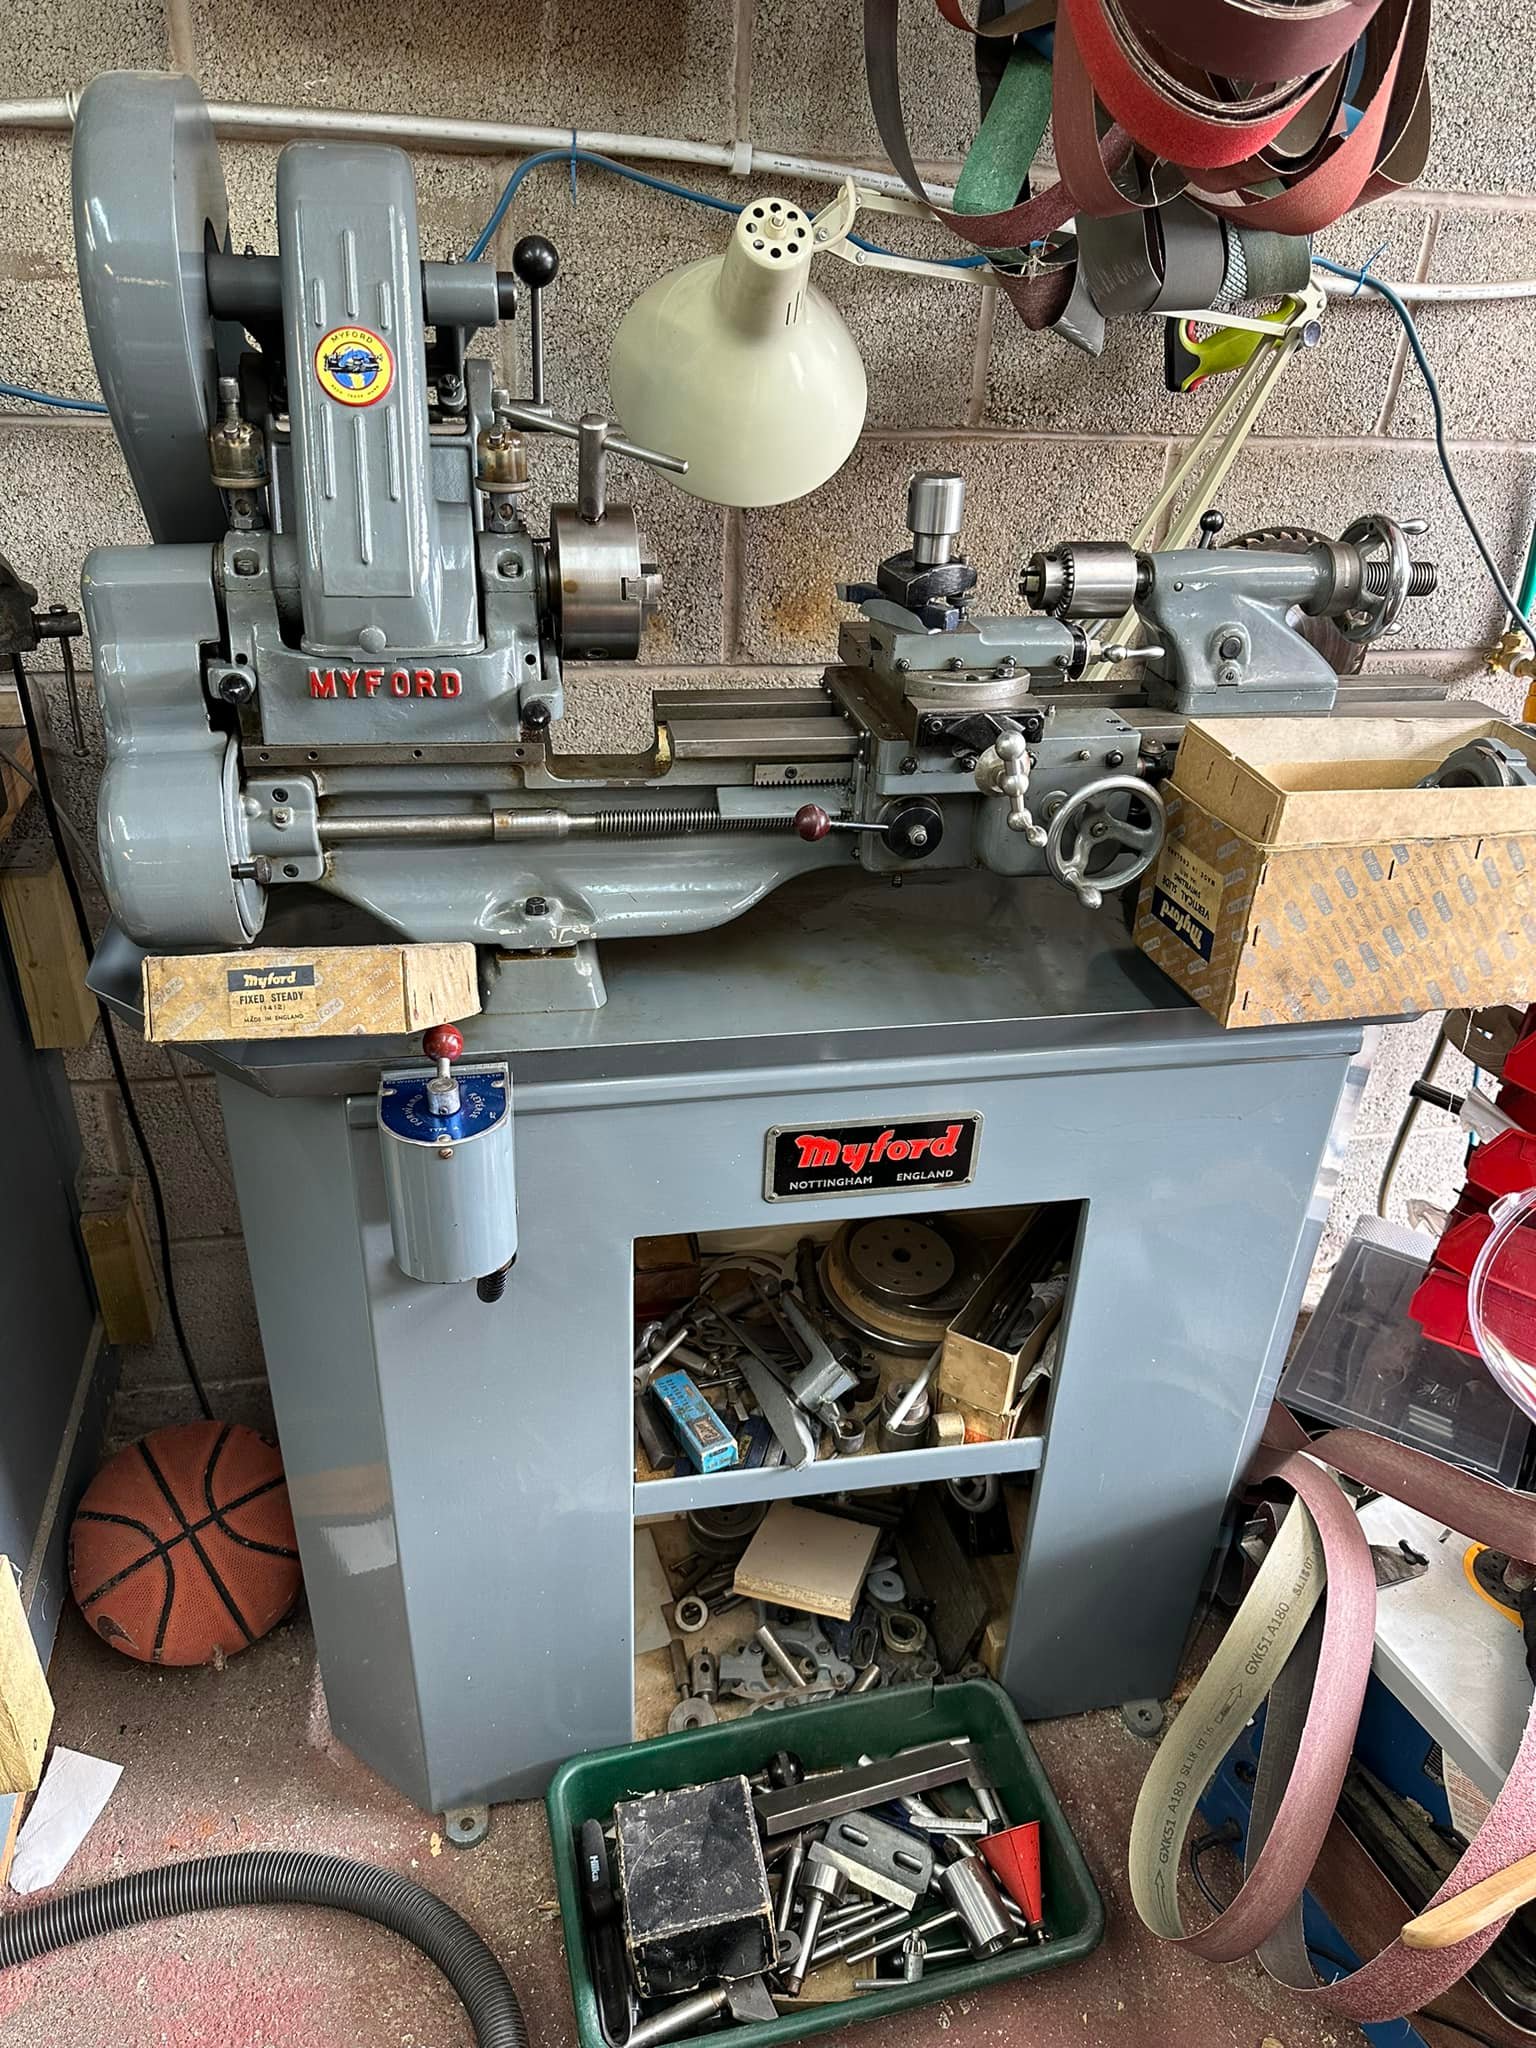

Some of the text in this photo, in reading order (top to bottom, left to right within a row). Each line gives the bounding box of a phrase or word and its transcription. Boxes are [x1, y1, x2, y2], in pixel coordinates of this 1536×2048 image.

[331, 331, 373, 343] MYFORD
[308, 666, 463, 699] MYFORD
[1161, 874, 1178, 894] SLIDE
[1181, 889, 1210, 921] VERTICAL
[1160, 899, 1203, 950] Myford
[243, 971, 297, 989] Myford
[240, 992, 304, 1004] FIXED STEADY
[274, 1013, 304, 1021] ENGLAND
[402, 1094, 424, 1127] FORWARD
[469, 1092, 486, 1119] REVERSE
[794, 1124, 964, 1174] Myford
[789, 1169, 954, 1191] NOTTINGHAM ENGLAND
[1245, 1636, 1273, 1676] GXK51
[1267, 1601, 1290, 1638] A180
[1159, 1820, 1177, 1864] GXK51
[1171, 1780, 1188, 1815] A180
[1180, 1750, 1199, 1778] SL18
[589, 1854, 600, 1882] Hilka
